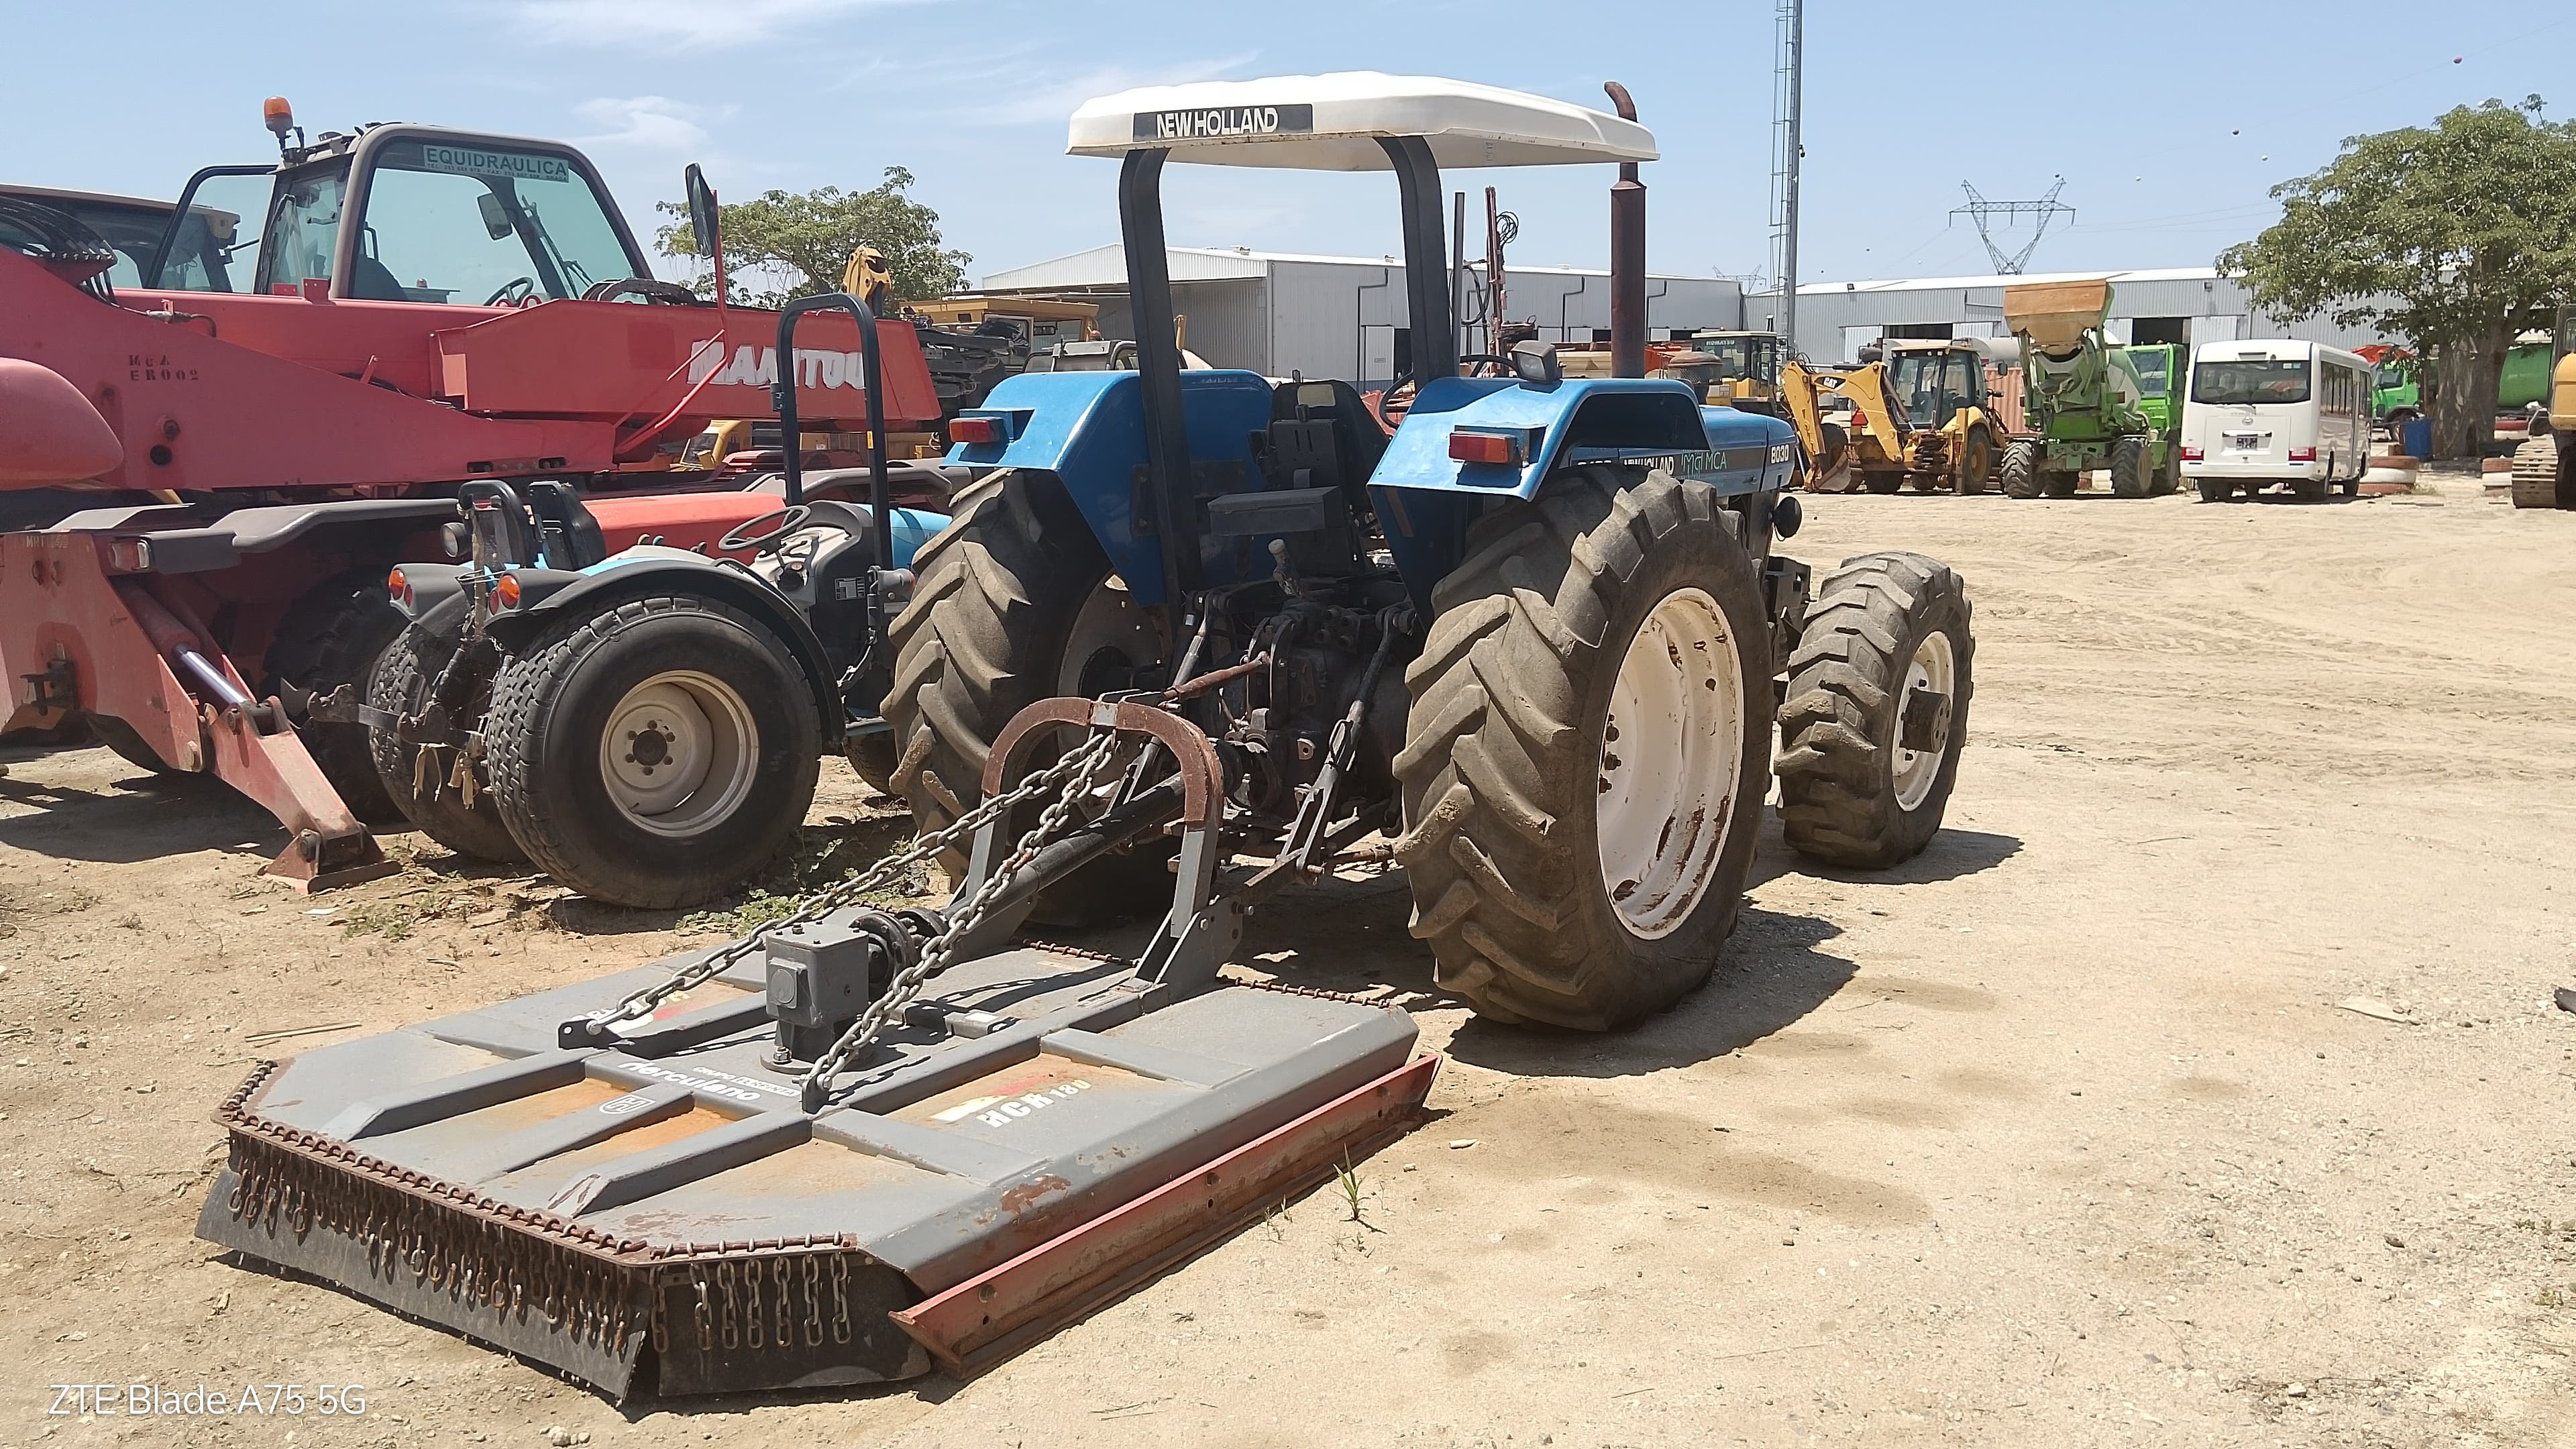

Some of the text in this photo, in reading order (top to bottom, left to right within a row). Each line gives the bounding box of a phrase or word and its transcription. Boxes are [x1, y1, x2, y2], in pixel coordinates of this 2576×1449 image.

[1157, 107, 1279, 139] NEW HOLLAND
[427, 148, 567, 176] EQUIDRAULICA
[1823, 377, 1838, 388] CAT
[1705, 451, 1727, 471] MCA
[1771, 444, 1789, 464] 8030
[976, 1092, 1055, 1128] HCR
